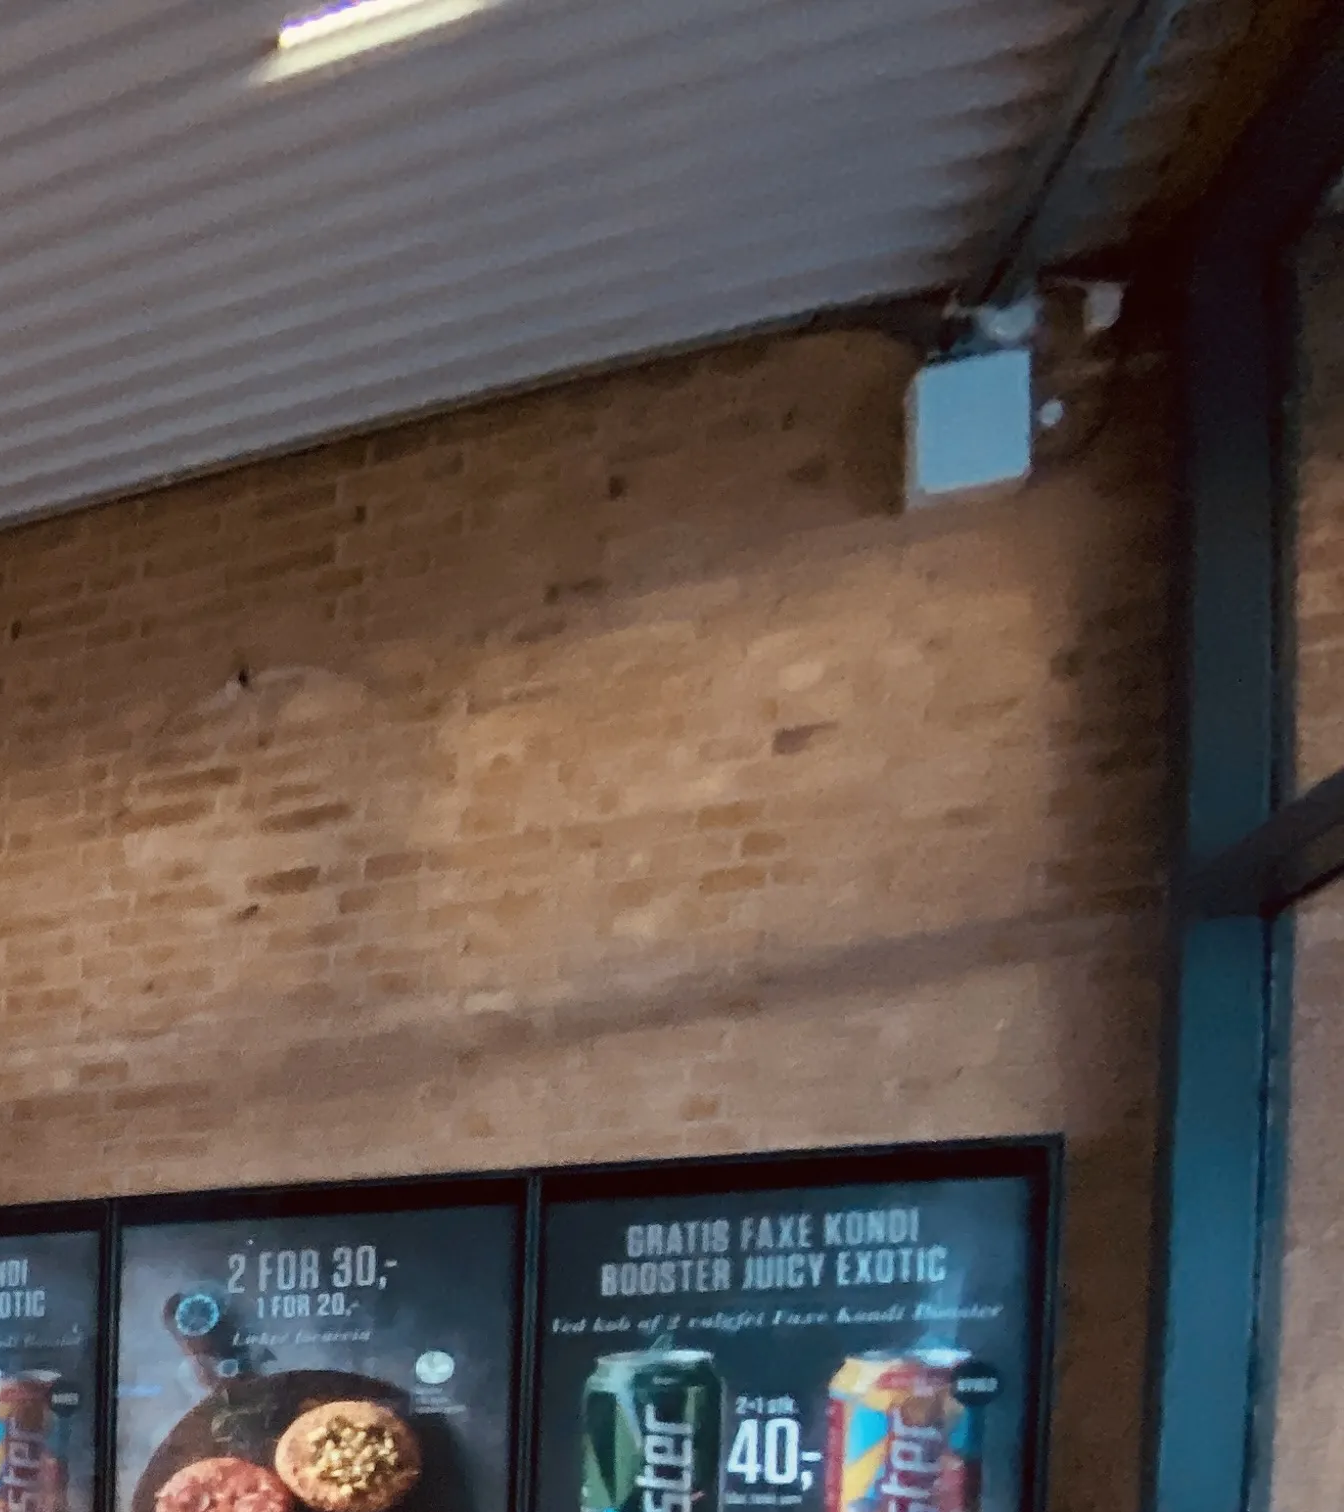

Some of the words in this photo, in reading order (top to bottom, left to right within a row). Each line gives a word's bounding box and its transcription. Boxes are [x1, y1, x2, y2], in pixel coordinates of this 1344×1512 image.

[626, 1219, 729, 1257] GRATIS
[740, 1213, 812, 1252] FAXE
[824, 1207, 920, 1246] KONDI
[227, 1253, 246, 1294] 2
[259, 1249, 319, 1292] FOR
[601, 1257, 731, 1297] BOOSTER
[741, 1253, 826, 1291] JUICY
[836, 1246, 947, 1287] EXOTIC
[257, 1297, 264, 1318] 1
[271, 1293, 310, 1318] FOR
